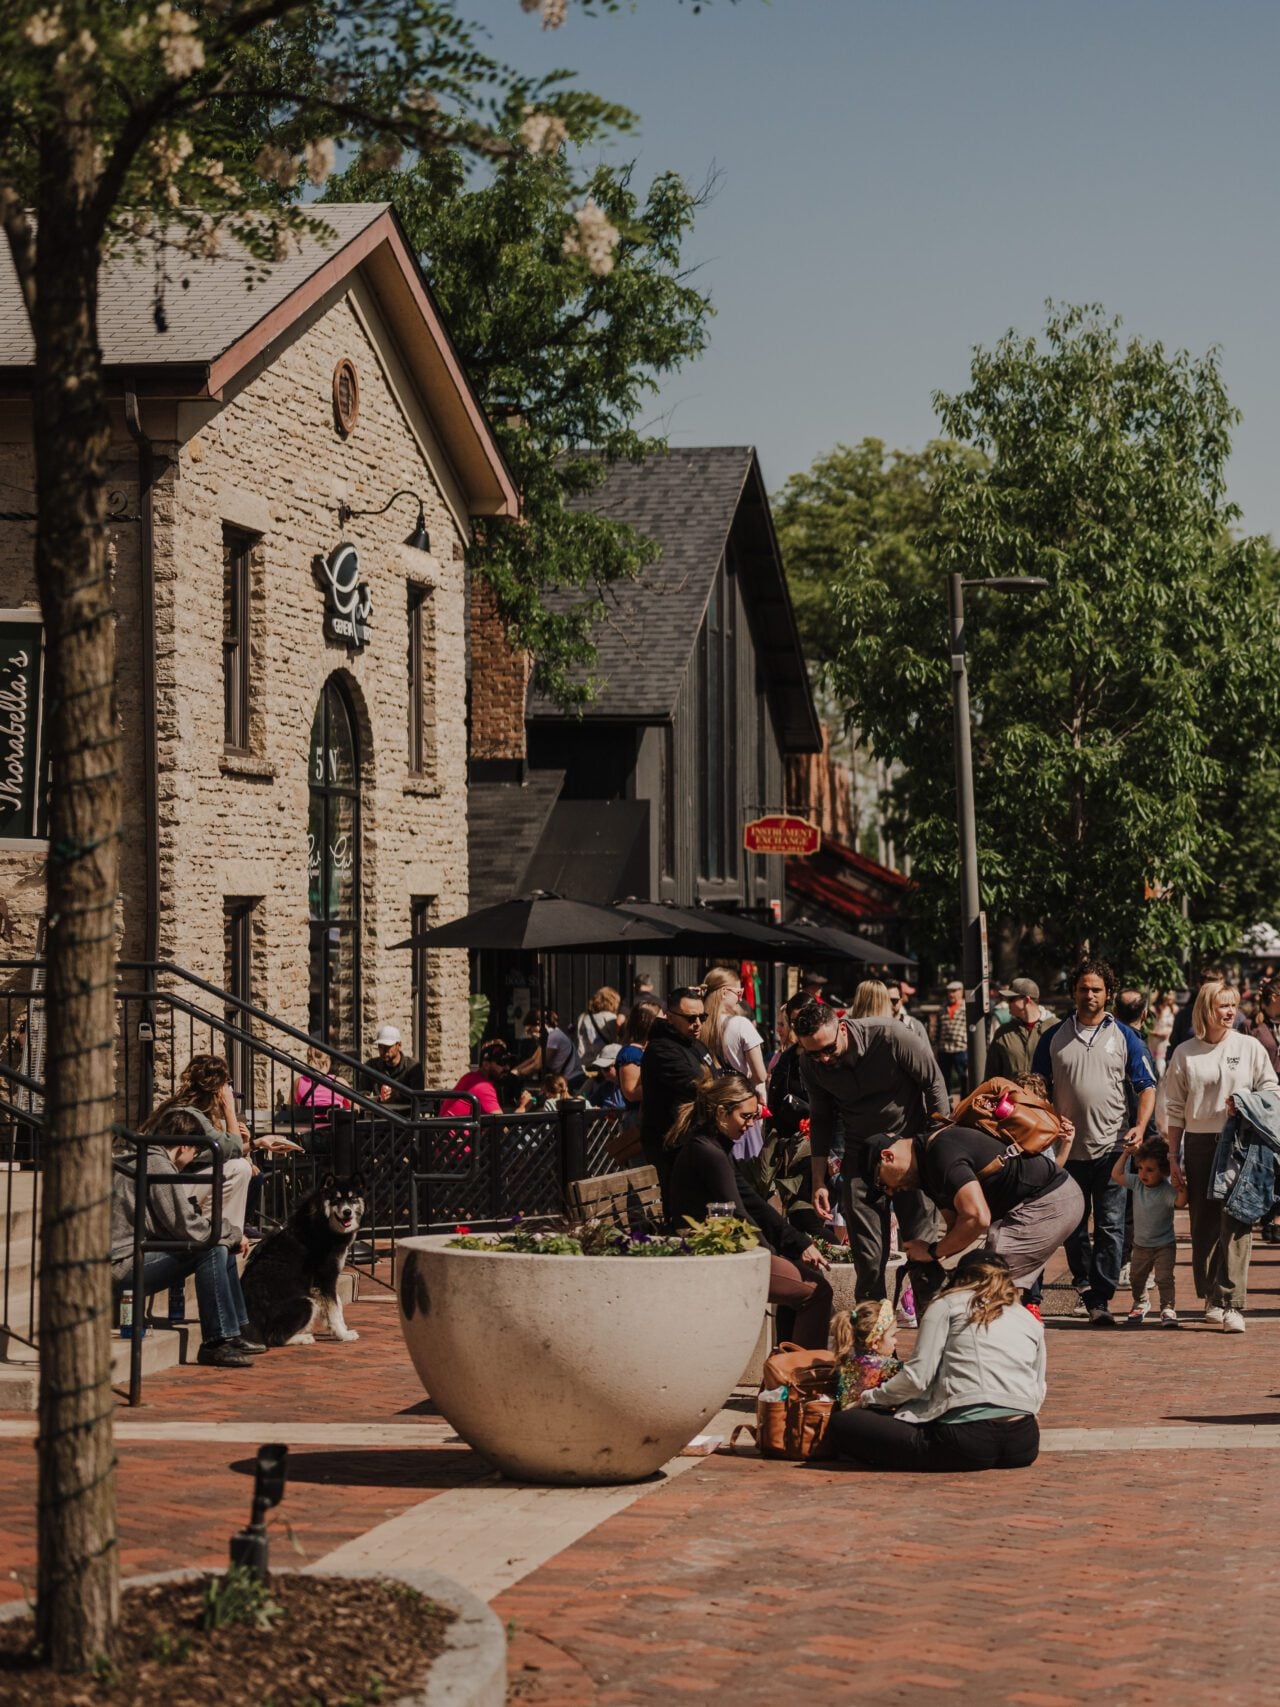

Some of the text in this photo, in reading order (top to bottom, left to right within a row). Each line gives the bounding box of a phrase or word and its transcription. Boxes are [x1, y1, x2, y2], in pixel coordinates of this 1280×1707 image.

[315, 746, 338, 782] 5 N
[751, 827, 813, 838] INSTRUMENT
[755, 836, 808, 847] EXCHANGE
